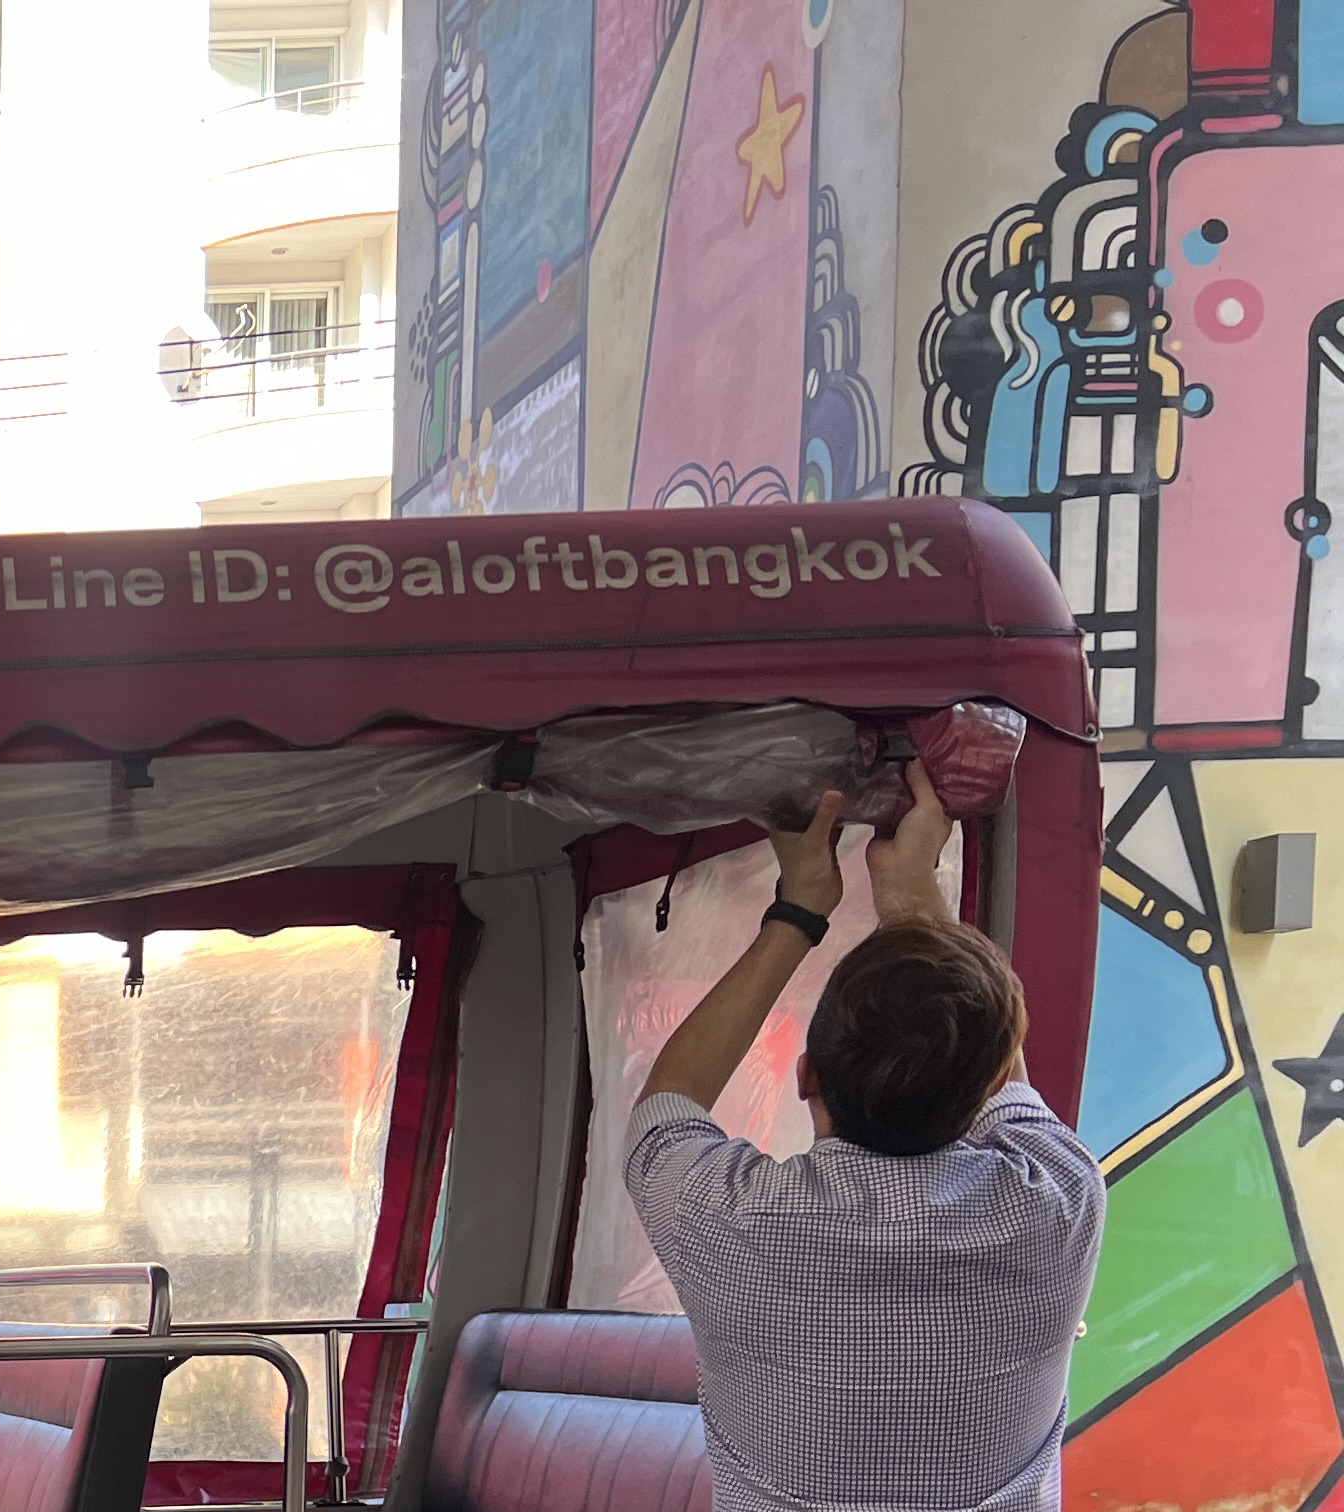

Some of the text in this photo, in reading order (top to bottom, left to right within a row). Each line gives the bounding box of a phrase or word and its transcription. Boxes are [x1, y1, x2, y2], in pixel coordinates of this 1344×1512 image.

[1, 554, 165, 611] Line
[188, 549, 294, 604] ID:
[314, 522, 943, 614] @aloftbangkok
